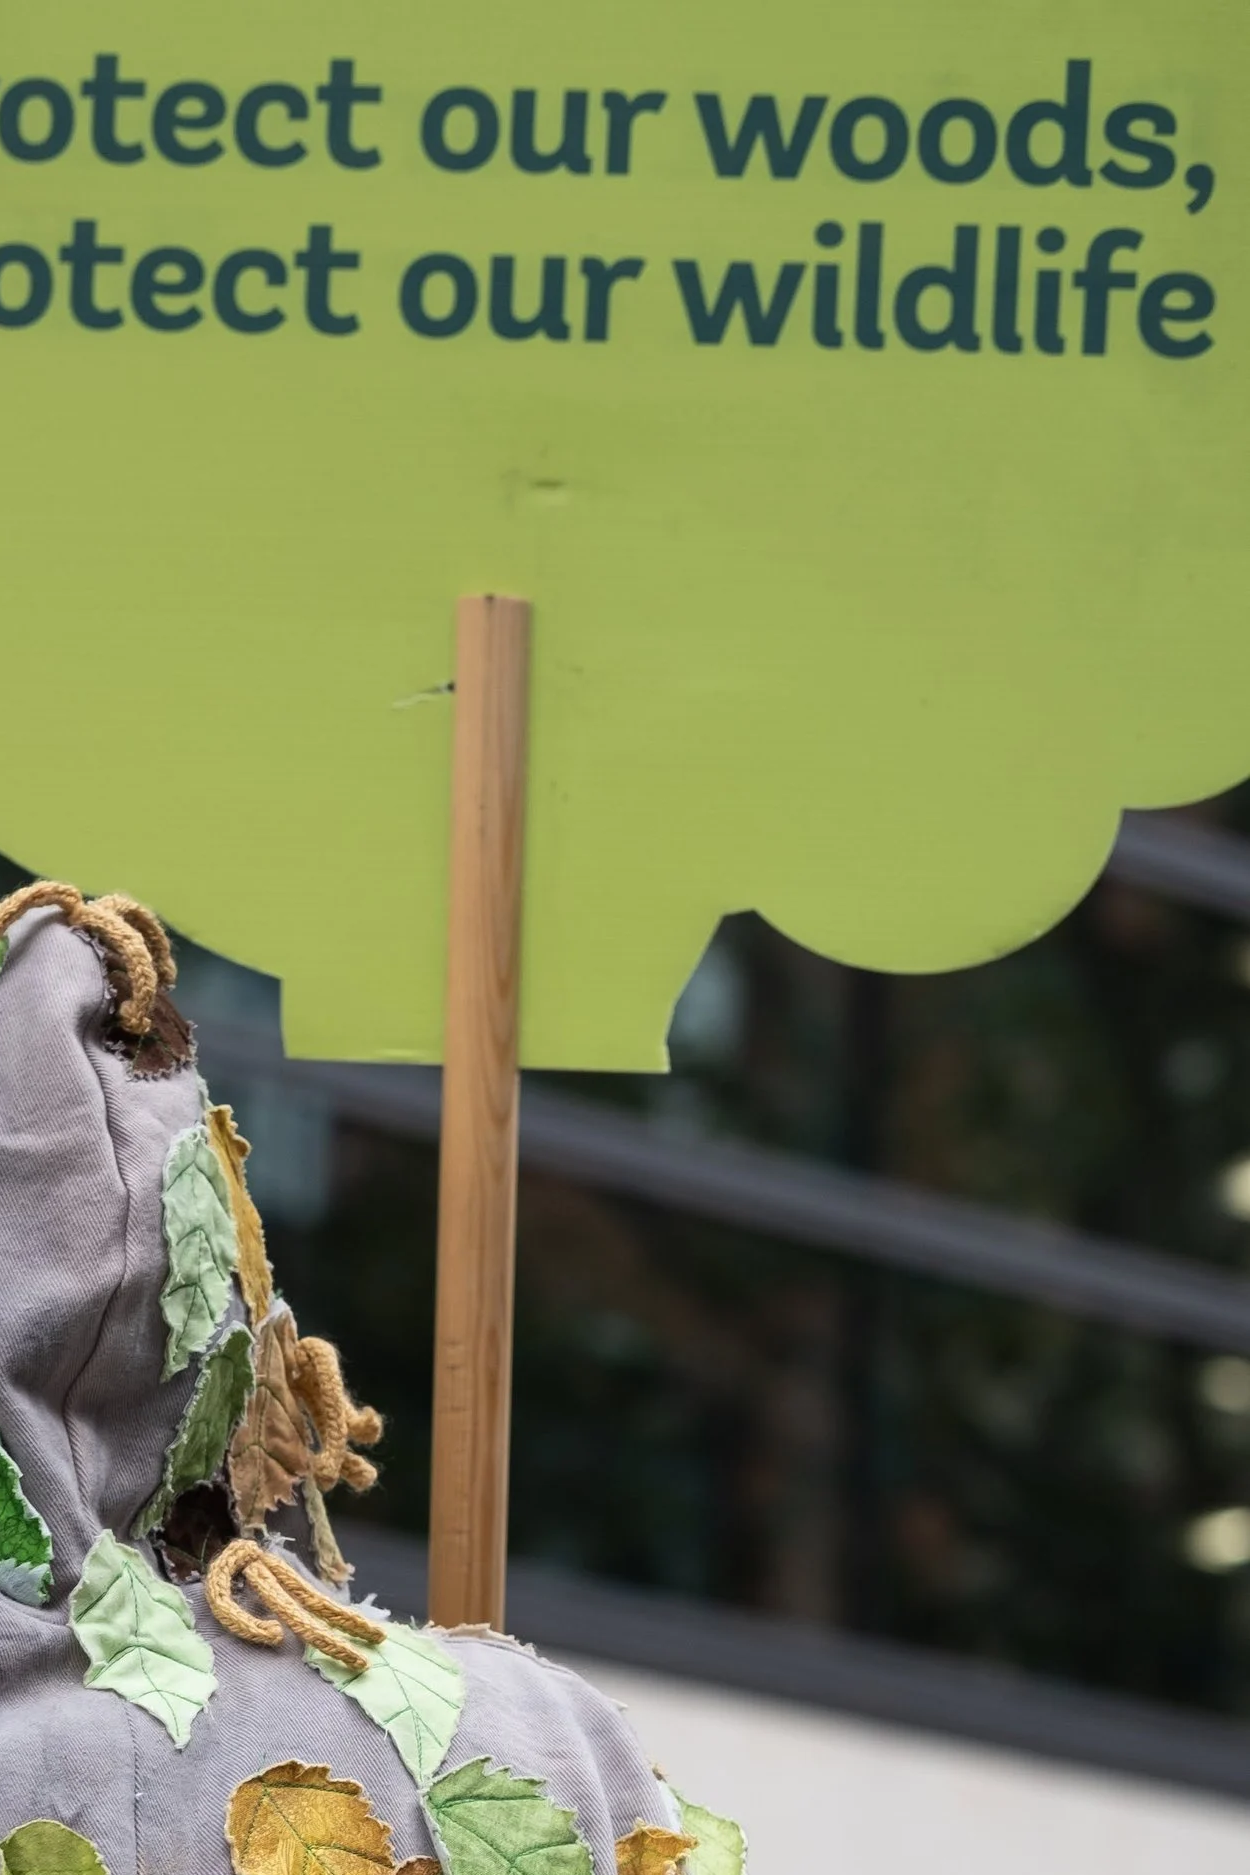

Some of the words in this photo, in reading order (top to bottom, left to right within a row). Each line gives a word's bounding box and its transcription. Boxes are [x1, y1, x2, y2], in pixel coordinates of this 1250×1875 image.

[419, 86, 668, 177] our
[693, 58, 1217, 216] woods,
[397, 252, 646, 344] our
[671, 220, 1217, 361] wildlife
